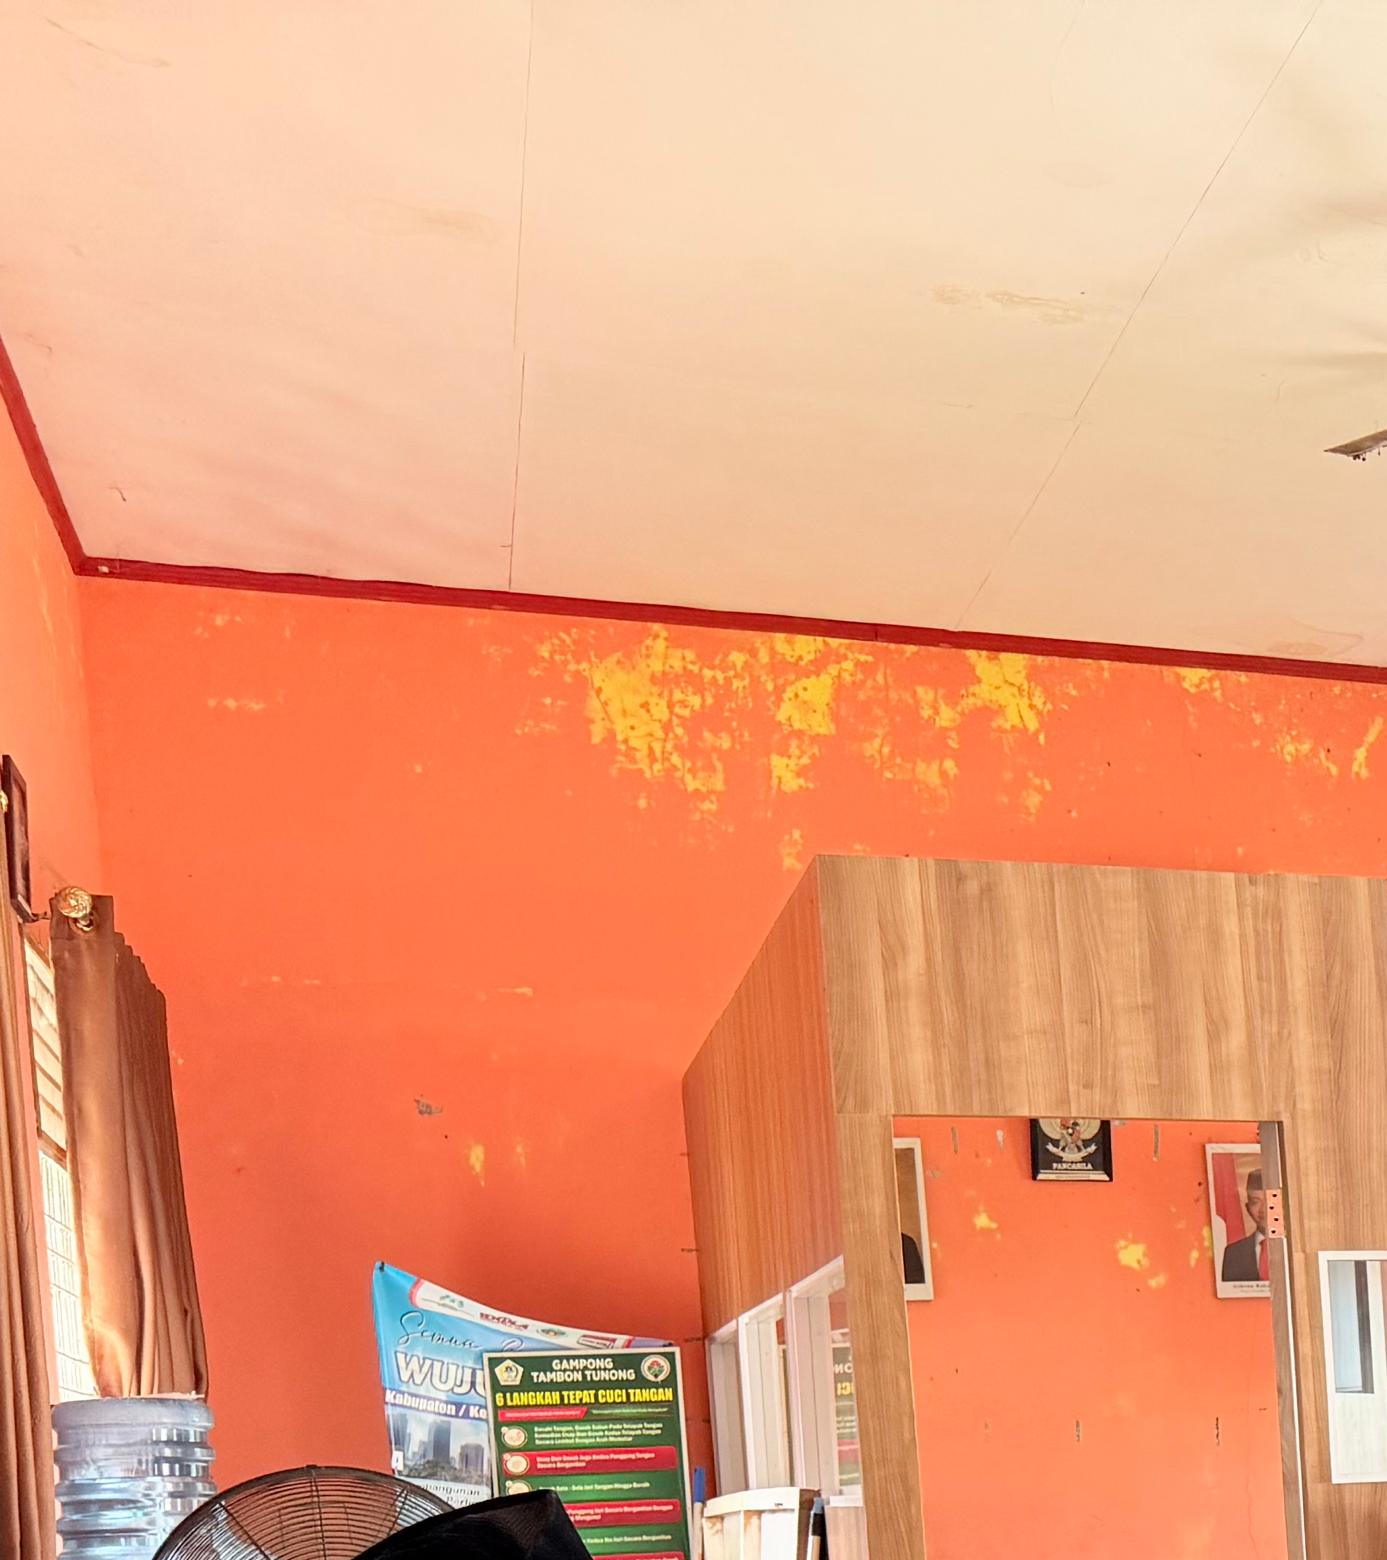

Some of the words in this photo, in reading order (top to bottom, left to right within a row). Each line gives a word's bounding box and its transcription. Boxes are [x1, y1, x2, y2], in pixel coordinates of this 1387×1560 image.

[1052, 1162, 1093, 1170] PANCASILA
[552, 1358, 613, 1370] GAMPONG
[531, 1371, 582, 1383] TAMBON
[584, 1369, 635, 1381] TUNONG
[496, 1394, 504, 1406] 6
[506, 1391, 560, 1406] LANGKAH
[562, 1390, 596, 1405] TEPAT
[598, 1389, 627, 1403] CUCI
[629, 1388, 672, 1402] TANGAN
